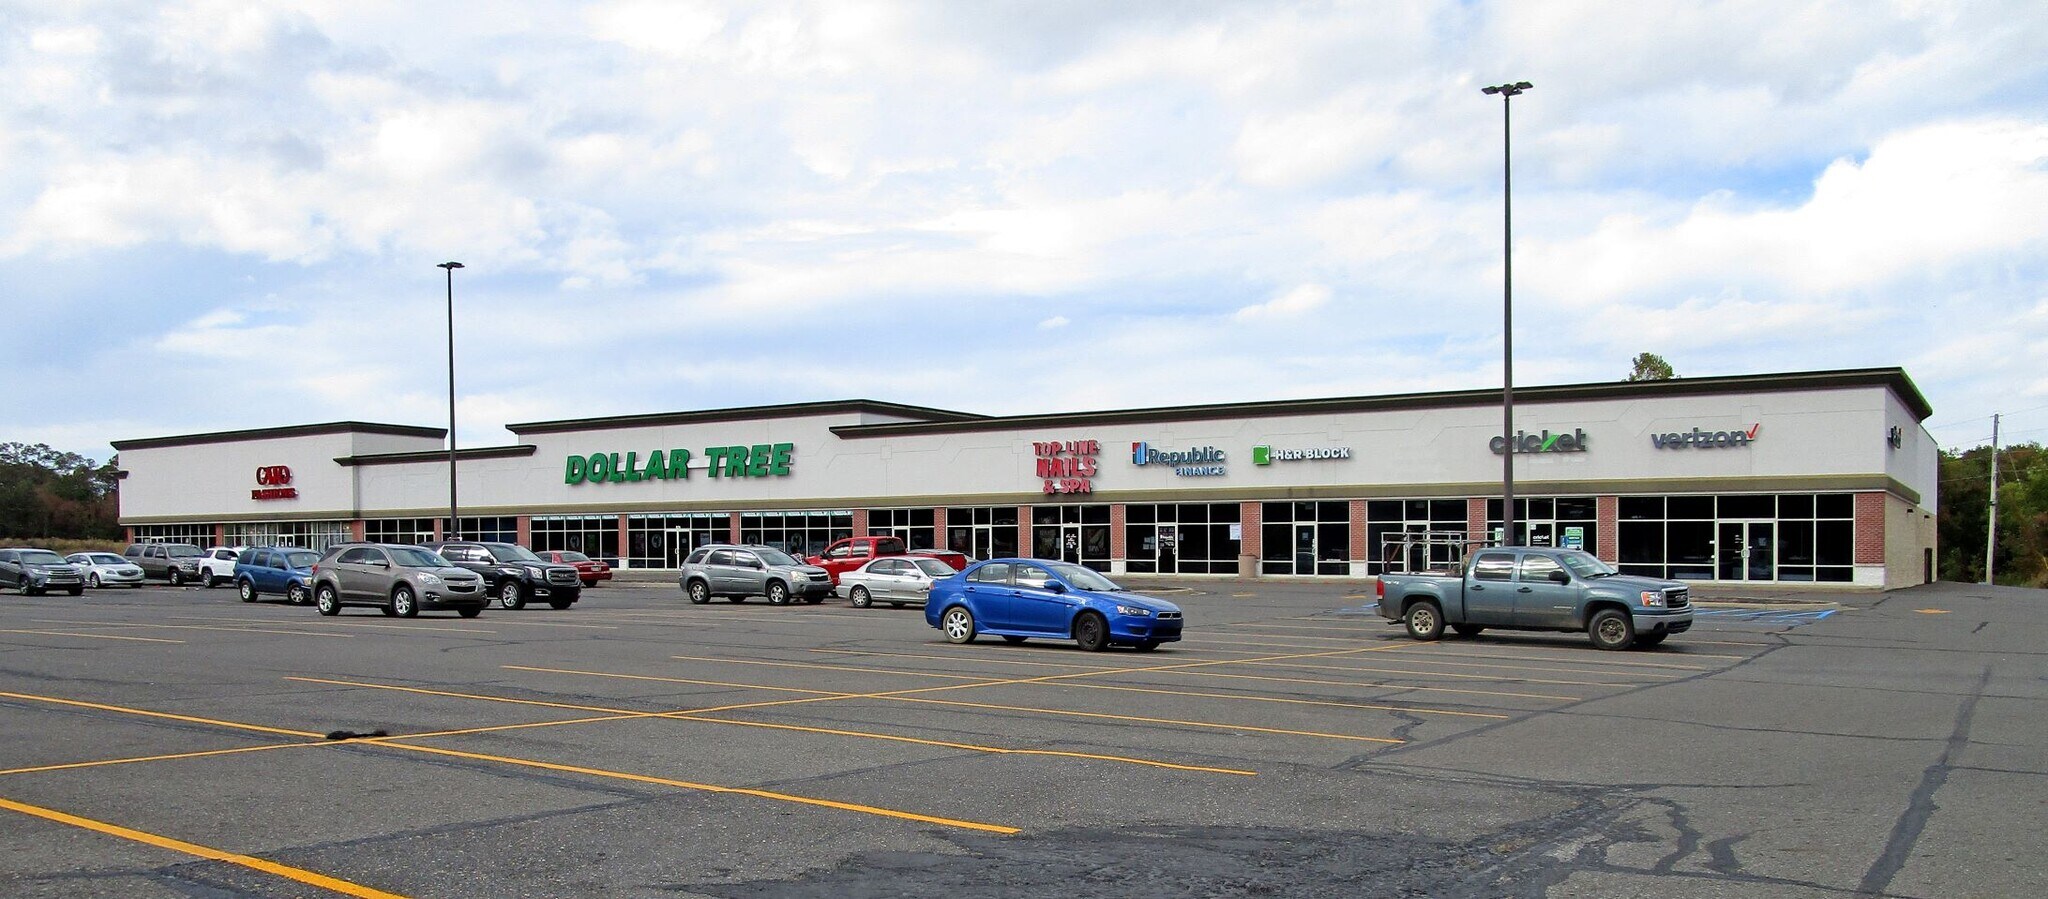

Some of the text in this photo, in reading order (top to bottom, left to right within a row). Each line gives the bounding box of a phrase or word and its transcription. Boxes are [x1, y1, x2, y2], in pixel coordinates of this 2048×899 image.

[1651, 427, 1747, 449] verizon
[1033, 439, 1098, 456] TOP LINE
[1148, 446, 1225, 466] Republic
[1275, 447, 1349, 460] H&R BLOCK
[565, 443, 794, 484] DOLLAR TREE
[1036, 456, 1096, 477] NAILS
[1176, 466, 1225, 477] FINANCE
[1043, 478, 1091, 494] & SPA
